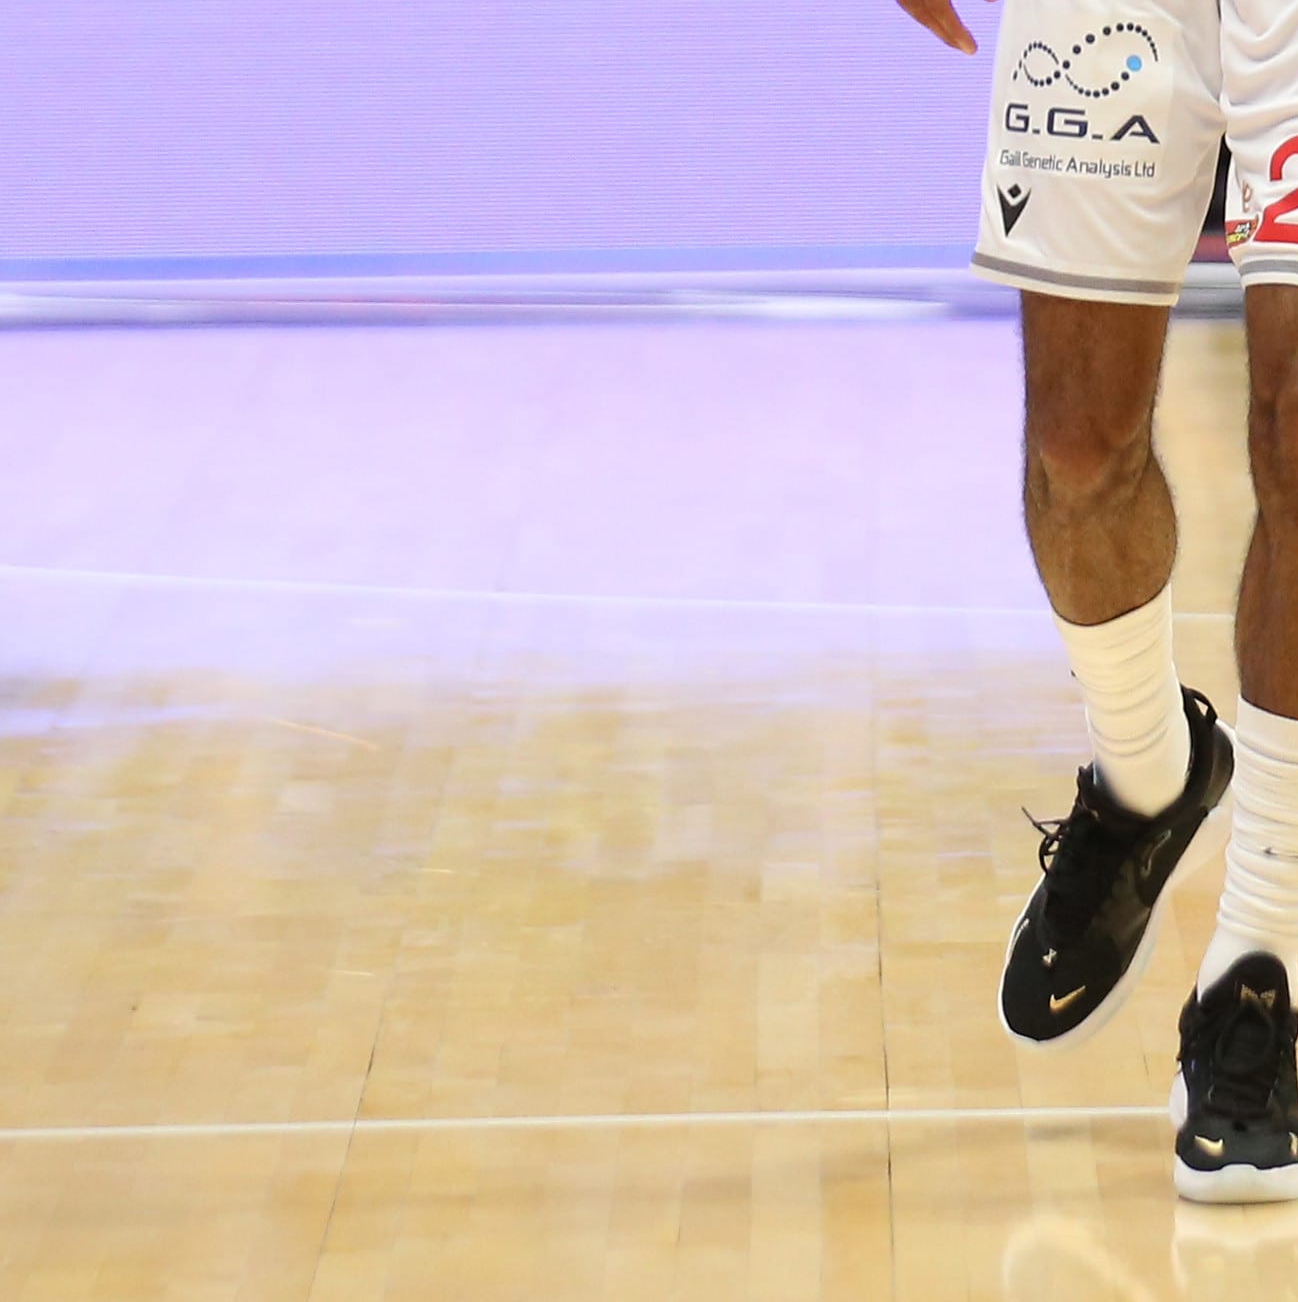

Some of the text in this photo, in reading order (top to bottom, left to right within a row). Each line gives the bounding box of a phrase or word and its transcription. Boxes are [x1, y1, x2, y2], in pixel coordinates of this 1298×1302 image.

[1022, 151, 1063, 171] Genetic
[1065, 156, 1132, 179] Analysis
[1134, 160, 1156, 178] Ltd
